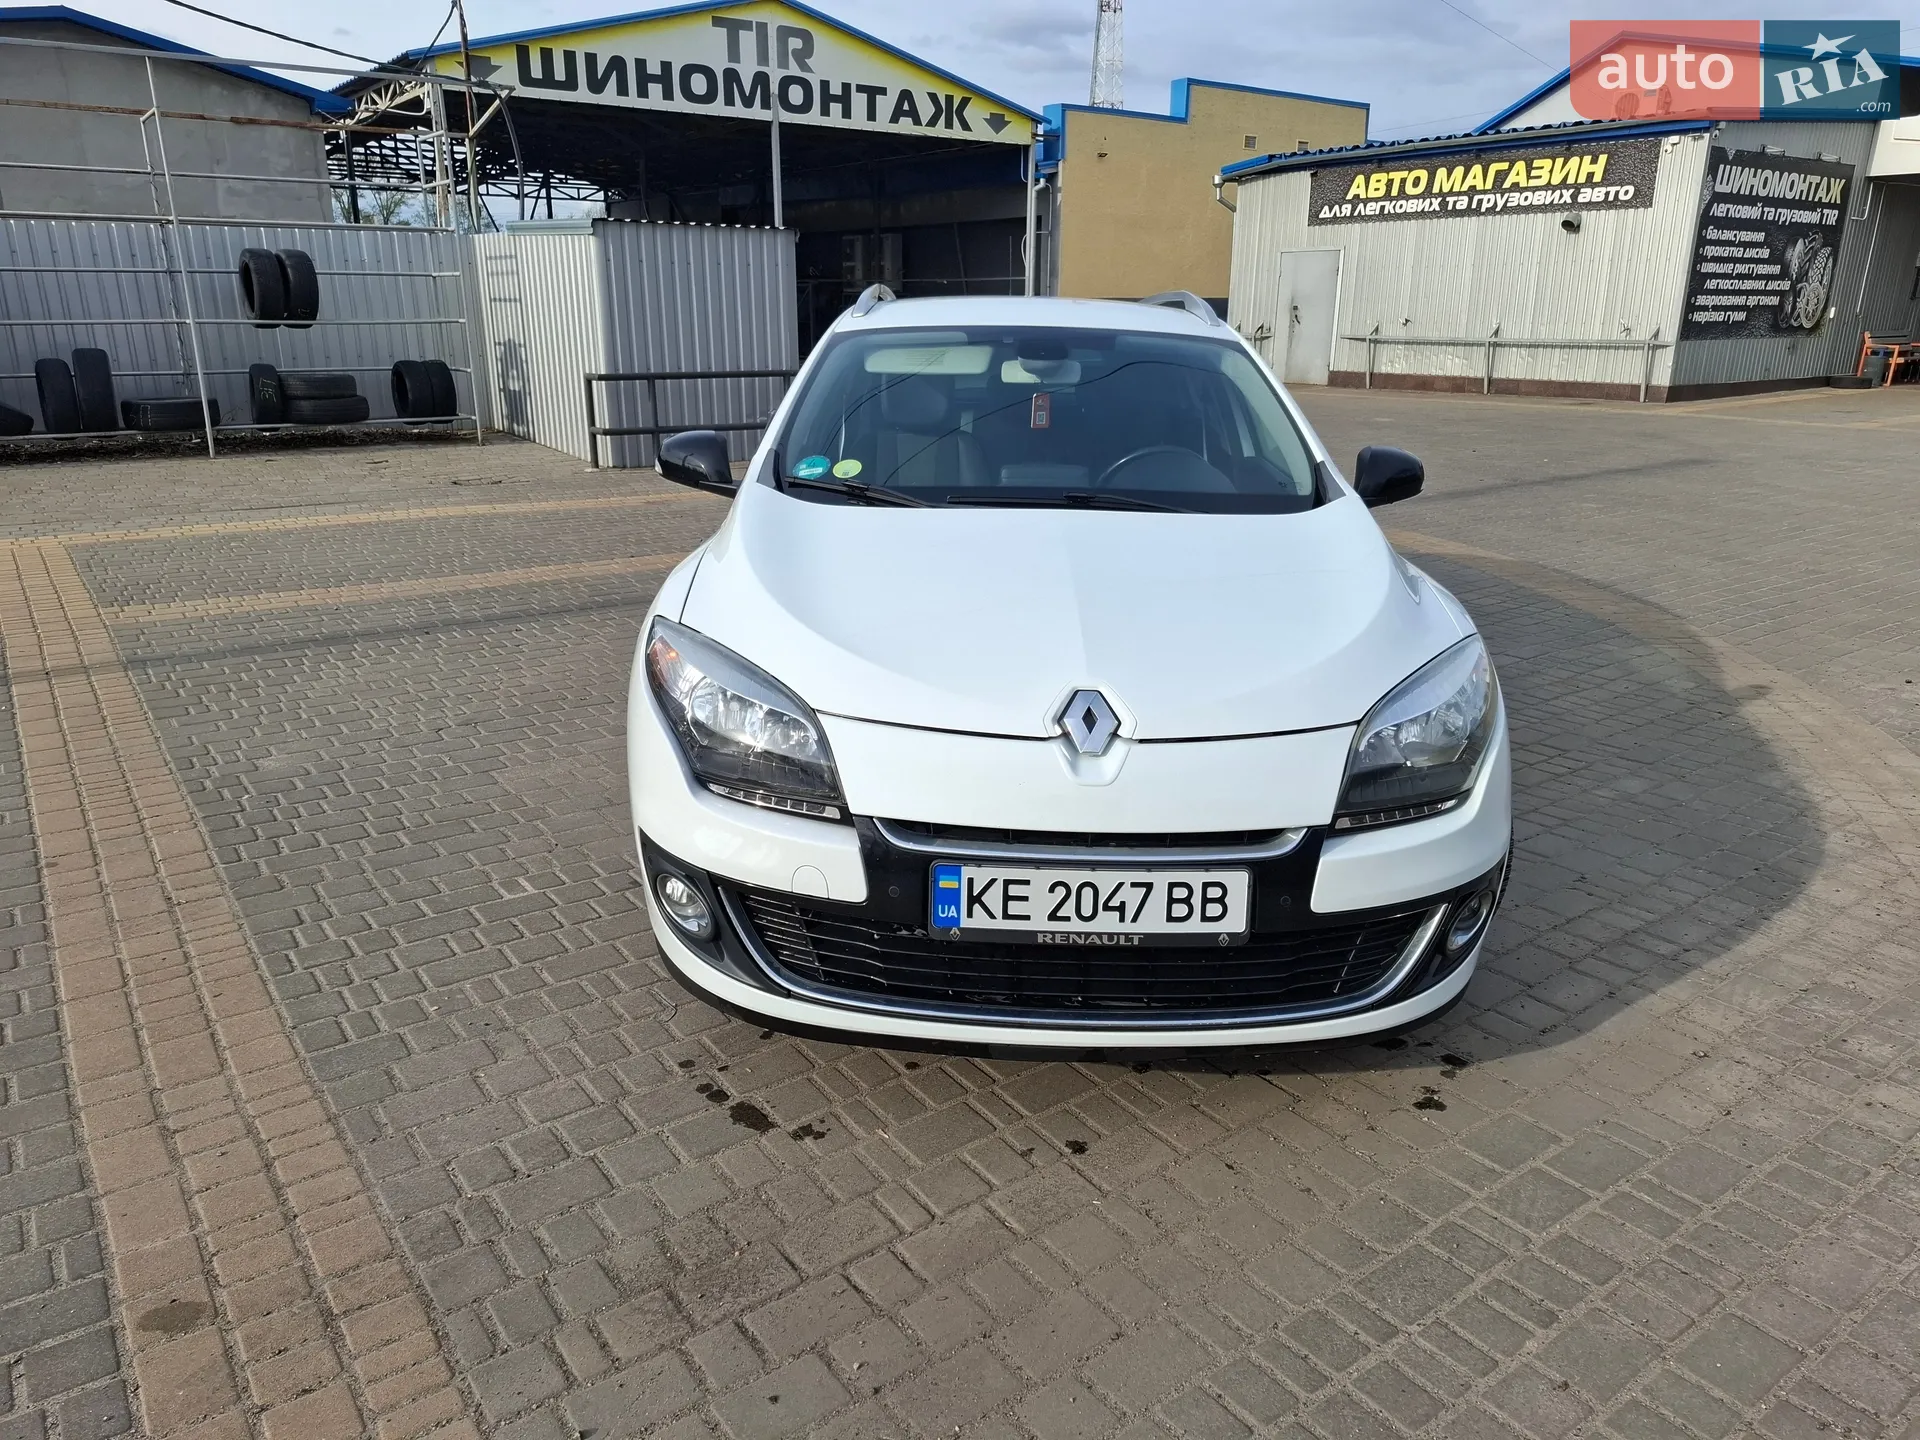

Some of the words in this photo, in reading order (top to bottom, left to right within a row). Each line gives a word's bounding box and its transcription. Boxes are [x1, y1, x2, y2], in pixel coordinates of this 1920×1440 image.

[711, 15, 815, 74] TIR
[515, 44, 973, 132] ШИНОМОНТАЖ
[1345, 169, 1429, 200] АВТО
[1432, 154, 1608, 194] МАГАЗИН
[1714, 164, 1846, 204] ШИНОМОНТАЖ
[1318, 203, 1352, 219] для
[1354, 197, 1442, 217] легкових
[1446, 195, 1468, 210] та
[1471, 188, 1575, 213] грузових
[1577, 185, 1635, 203] авто
[1709, 202, 1763, 220] легковий
[1763, 207, 1774, 220] та
[1775, 208, 1822, 226] грузовий
[1822, 208, 1839, 226] TIR
[1706, 225, 1766, 244] балансування
[1703, 245, 1743, 259] прокатка
[1743, 246, 1770, 259] дисків
[1700, 262, 1734, 274] швидке
[1733, 263, 1781, 277] рихтування
[1704, 279, 1766, 290] легкосплавних
[1766, 278, 1791, 291] дисків
[1695, 295, 1747, 308] зварювання
[1747, 295, 1780, 308] аргоном
[1692, 309, 1725, 324] нарізка
[1725, 311, 1747, 324] гуми
[966, 877, 1031, 920] KE
[1047, 881, 1154, 923] 2047
[1165, 881, 1228, 923] BB
[938, 905, 957, 918] UA
[1037, 933, 1143, 945] RENAULT
